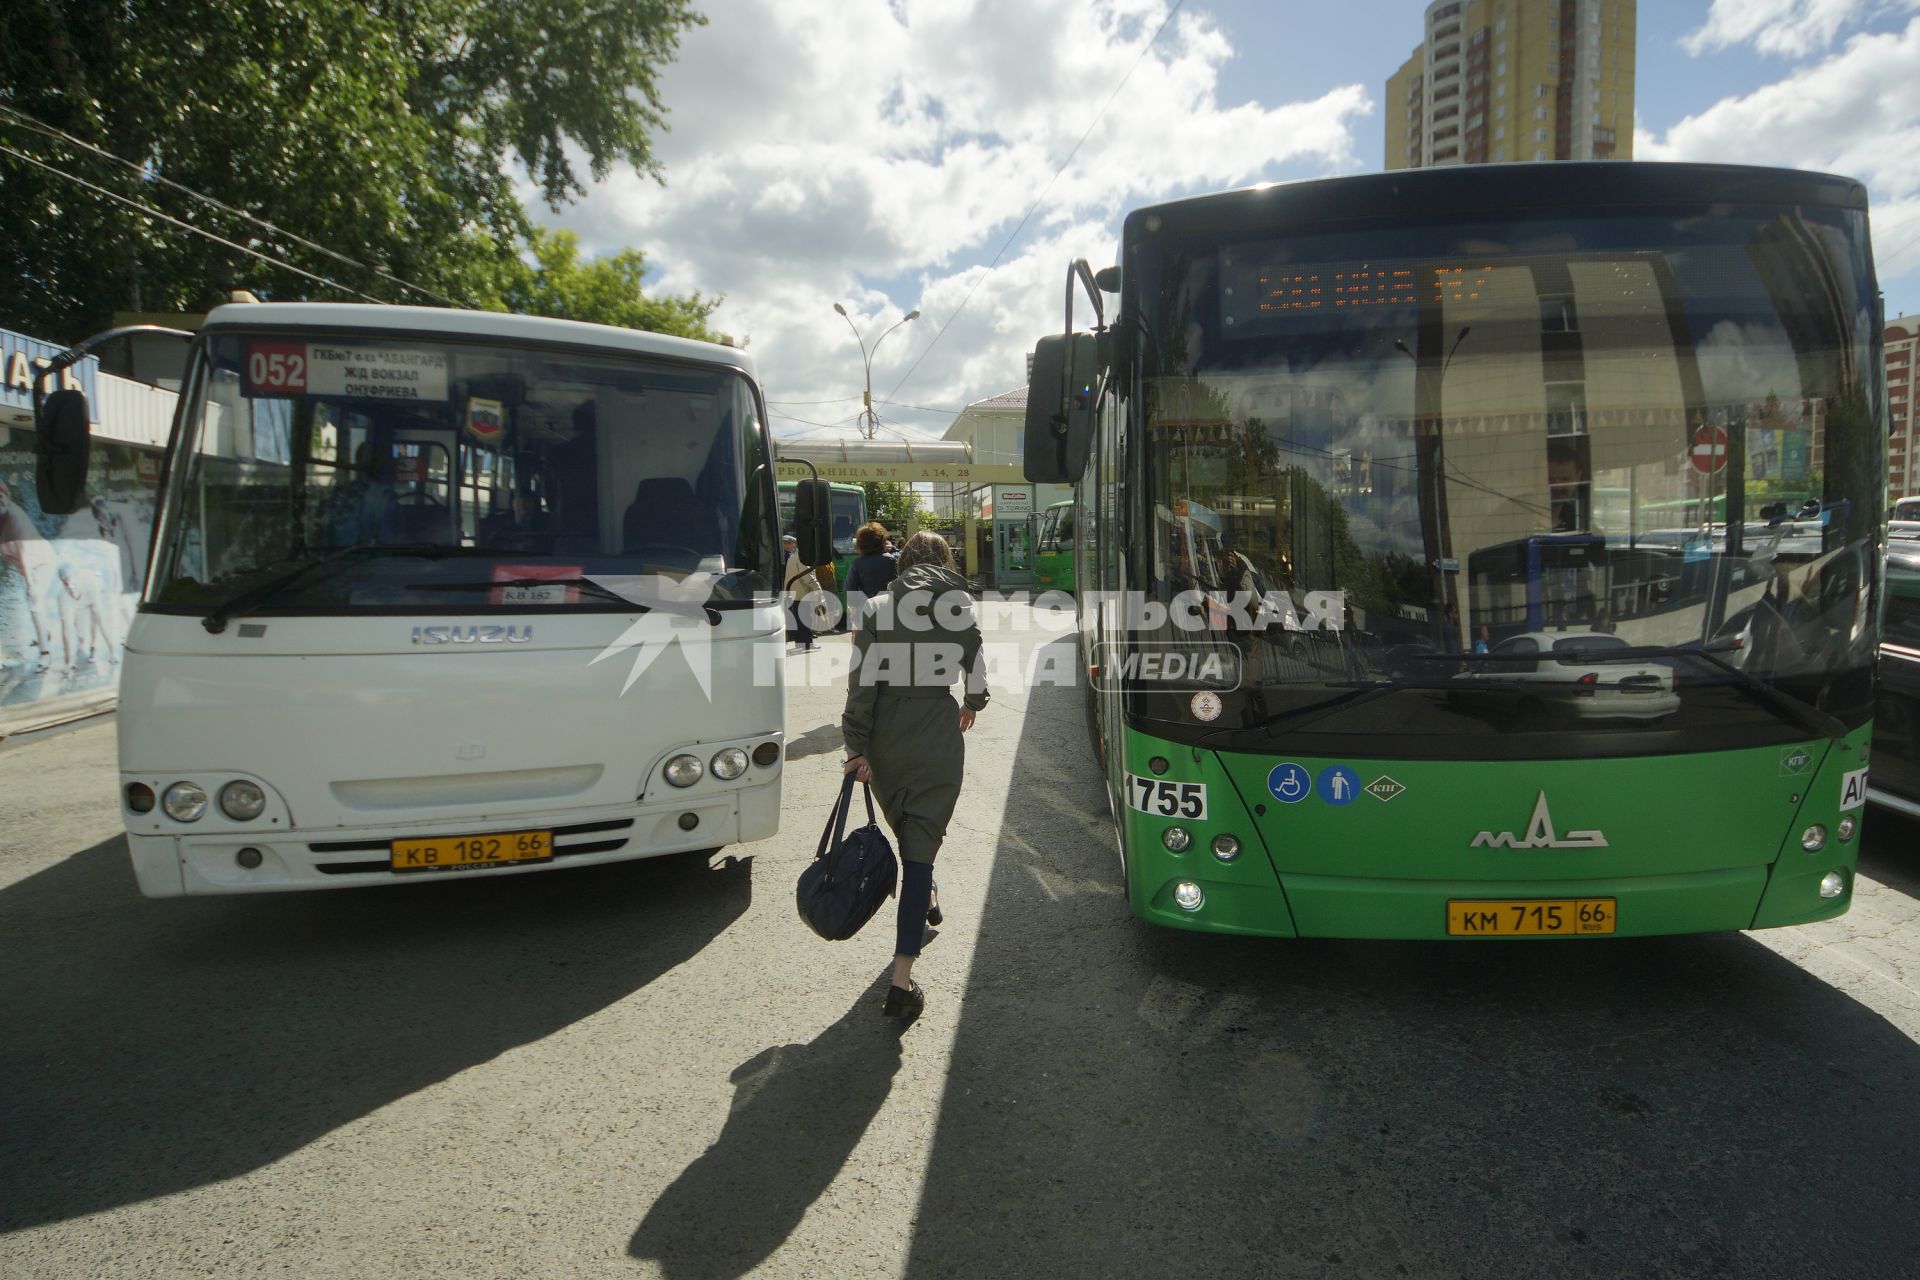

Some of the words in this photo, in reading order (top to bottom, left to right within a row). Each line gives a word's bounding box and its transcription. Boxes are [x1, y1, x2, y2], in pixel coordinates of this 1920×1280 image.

[250, 352, 304, 387] 052
[371, 368, 419, 381] ВОКЗАЛ
[345, 384, 418, 398] ОНУФРИЕВА
[411, 625, 533, 645] ISUZU
[1125, 774, 1203, 818] 1755
[454, 839, 501, 861] 182
[517, 835, 542, 851] 66
[1511, 906, 1562, 930] 715
[1579, 904, 1606, 922] 66
